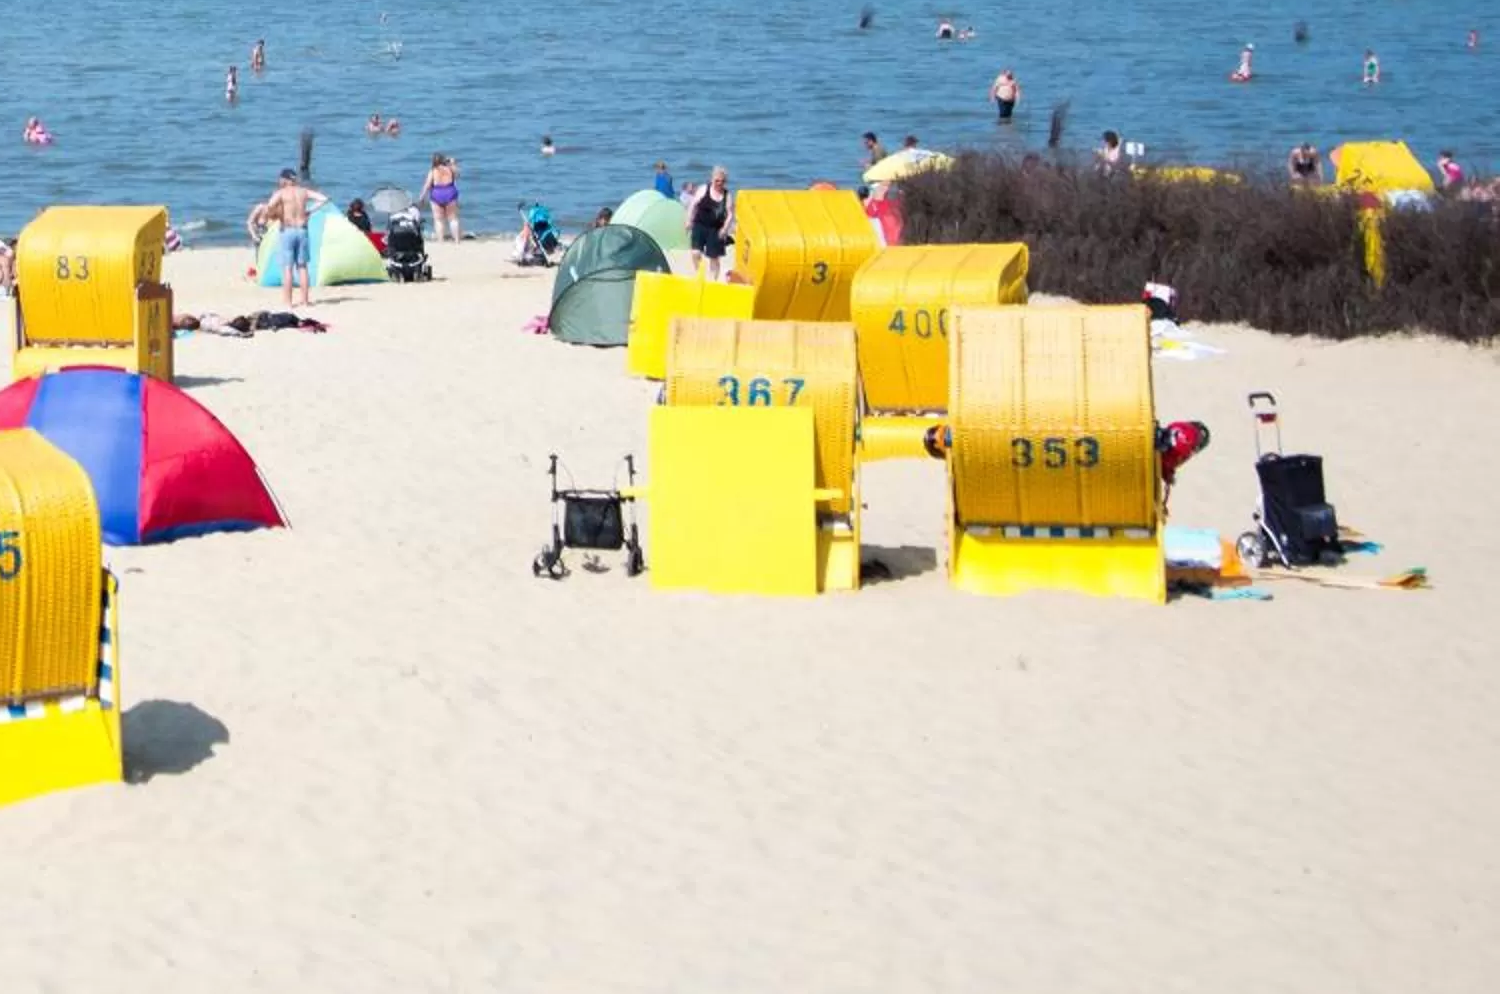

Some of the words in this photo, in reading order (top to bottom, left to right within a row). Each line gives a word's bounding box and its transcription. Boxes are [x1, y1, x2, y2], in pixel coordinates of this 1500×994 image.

[56, 256, 90, 280] 83
[811, 262, 828, 285] 3
[716, 376, 805, 406] 367
[1011, 436, 1099, 469] 353
